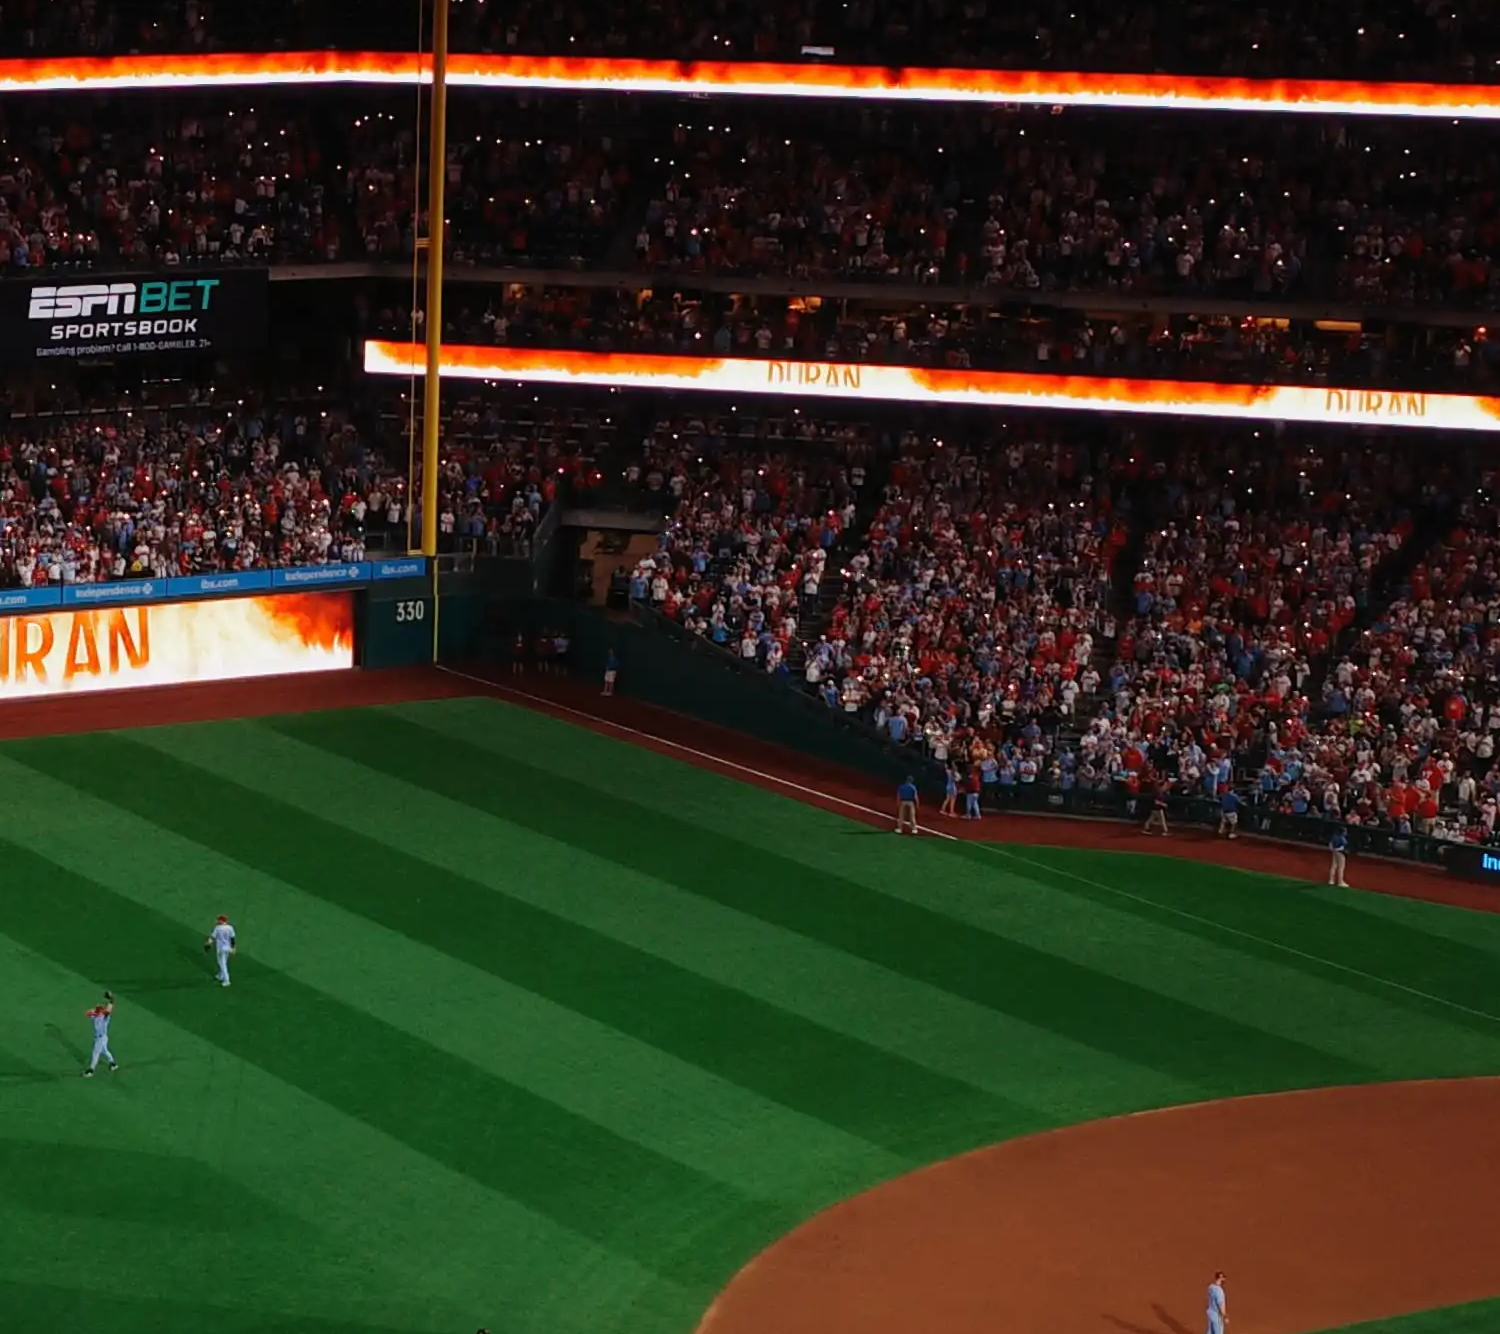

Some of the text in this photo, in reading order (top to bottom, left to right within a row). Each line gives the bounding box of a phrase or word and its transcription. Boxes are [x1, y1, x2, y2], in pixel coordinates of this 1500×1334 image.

[28, 279, 220, 319] ESPN BET
[50, 318, 198, 340] SPORTSBOOK
[396, 601, 424, 623] 330
